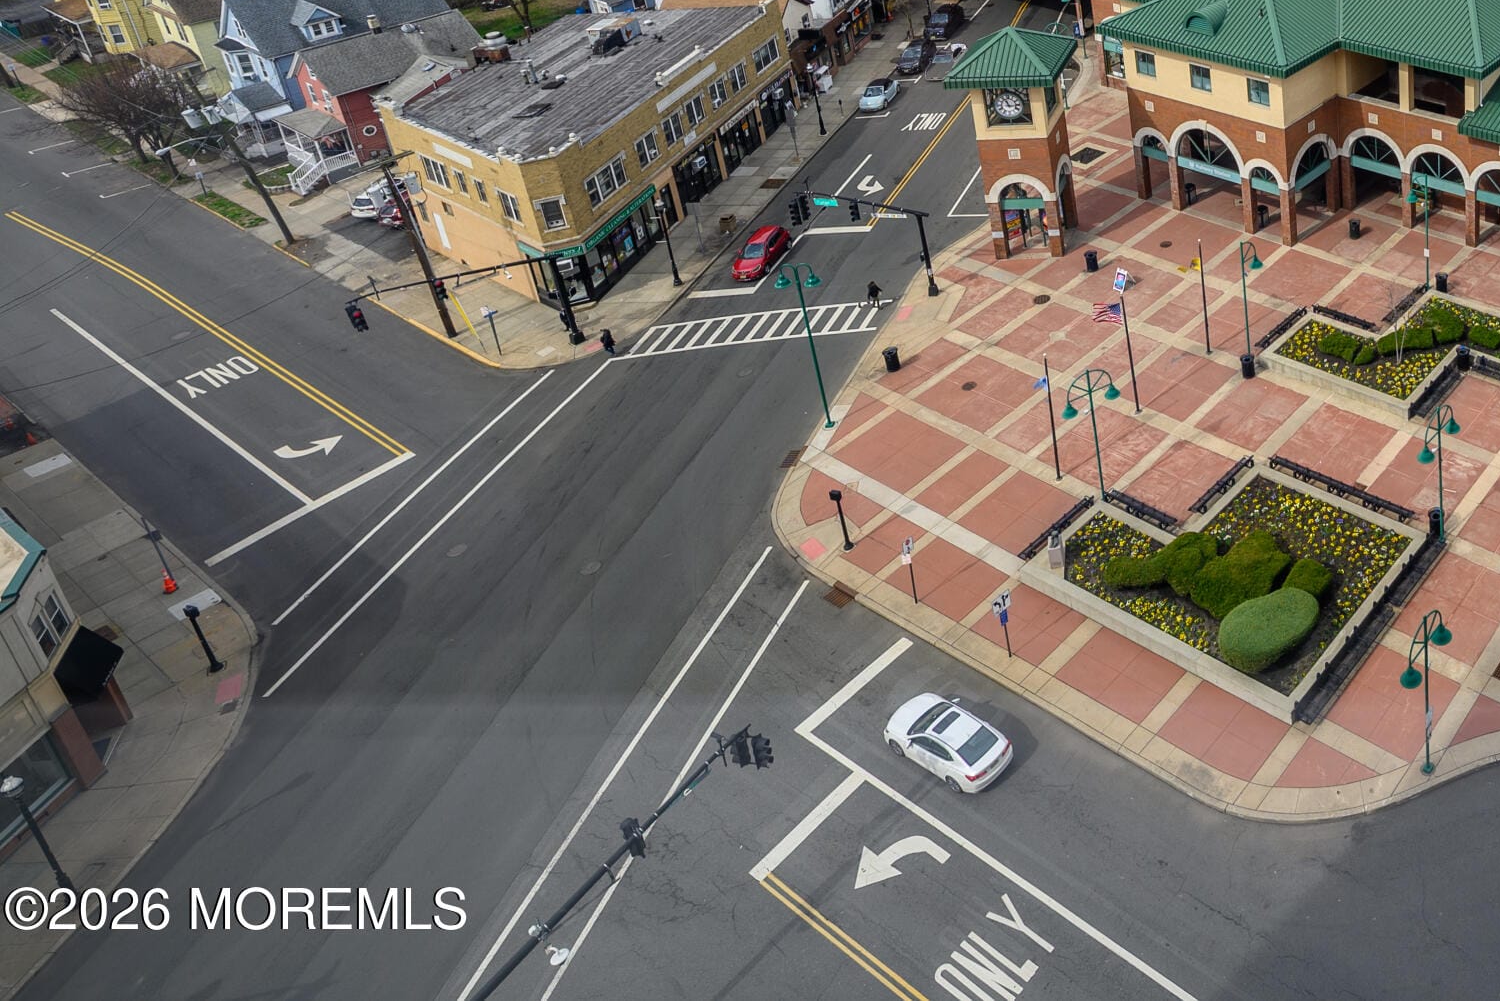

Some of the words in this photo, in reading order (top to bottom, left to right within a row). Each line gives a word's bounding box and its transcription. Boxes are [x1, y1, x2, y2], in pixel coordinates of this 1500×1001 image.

[901, 112, 947, 132] ONLY
[586, 230, 606, 248] ORGANIC
[605, 212, 627, 232] CLEANING
[629, 188, 655, 211] ALTERATIONS
[176, 356, 260, 399] ONLY
[934, 893, 1055, 1001] ONLY
